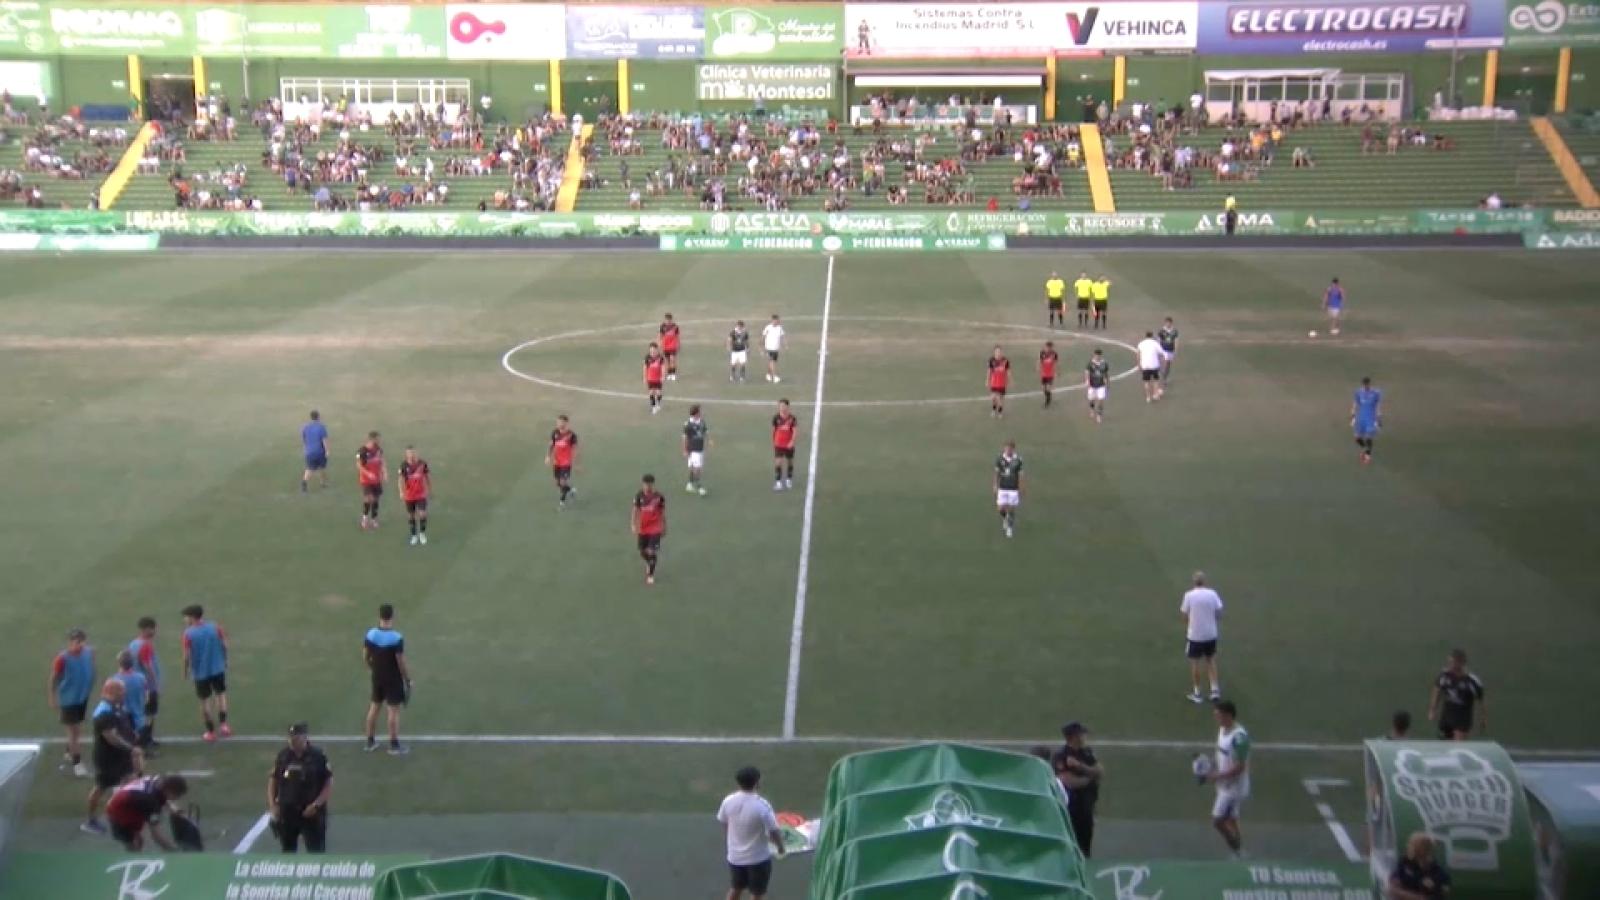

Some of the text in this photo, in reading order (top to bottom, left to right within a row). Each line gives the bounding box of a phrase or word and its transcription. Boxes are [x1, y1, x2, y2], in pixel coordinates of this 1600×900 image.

[913, 7, 1023, 18] Sistemas Contra
[1231, 4, 1466, 33] ELECTROCASH
[896, 20, 958, 30] Incendios
[961, 19, 1009, 30] Madrid
[1103, 19, 1187, 36] VEHINCA
[1302, 38, 1388, 51] electrocash.es
[699, 64, 831, 79] Clínica Veterinaria
[747, 82, 832, 99] Montesol
[734, 212, 811, 227] ACTUA
[1215, 213, 1274, 226] CMA
[1397, 773, 1509, 796] SMASH
[234, 861, 250, 877] La
[296, 863, 321, 879] que
[321, 861, 358, 878] cuida
[359, 861, 376, 877] de
[240, 882, 290, 900] Sonrisa
[291, 883, 313, 900] del
